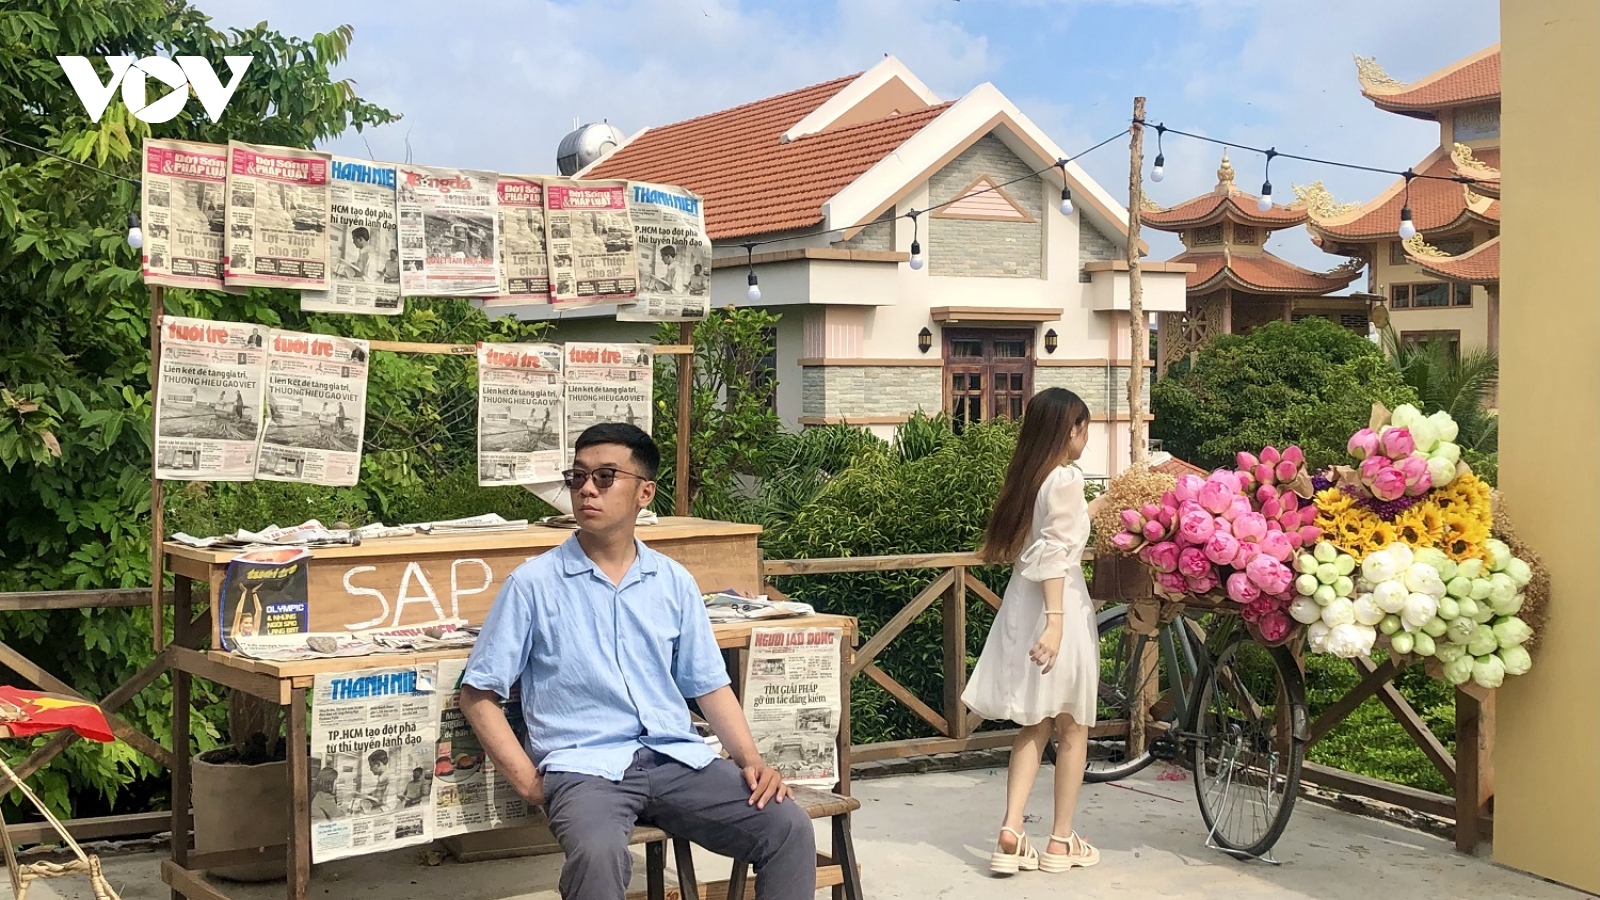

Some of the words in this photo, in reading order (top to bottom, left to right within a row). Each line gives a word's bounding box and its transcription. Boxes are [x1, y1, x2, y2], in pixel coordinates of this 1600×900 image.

[266, 604, 304, 613] OLYMPIC
[331, 673, 389, 701] THANH
[328, 728, 363, 741] TP.HCM
[365, 727, 381, 739] tạo
[399, 721, 417, 736] phá
[405, 734, 422, 747] đạo
